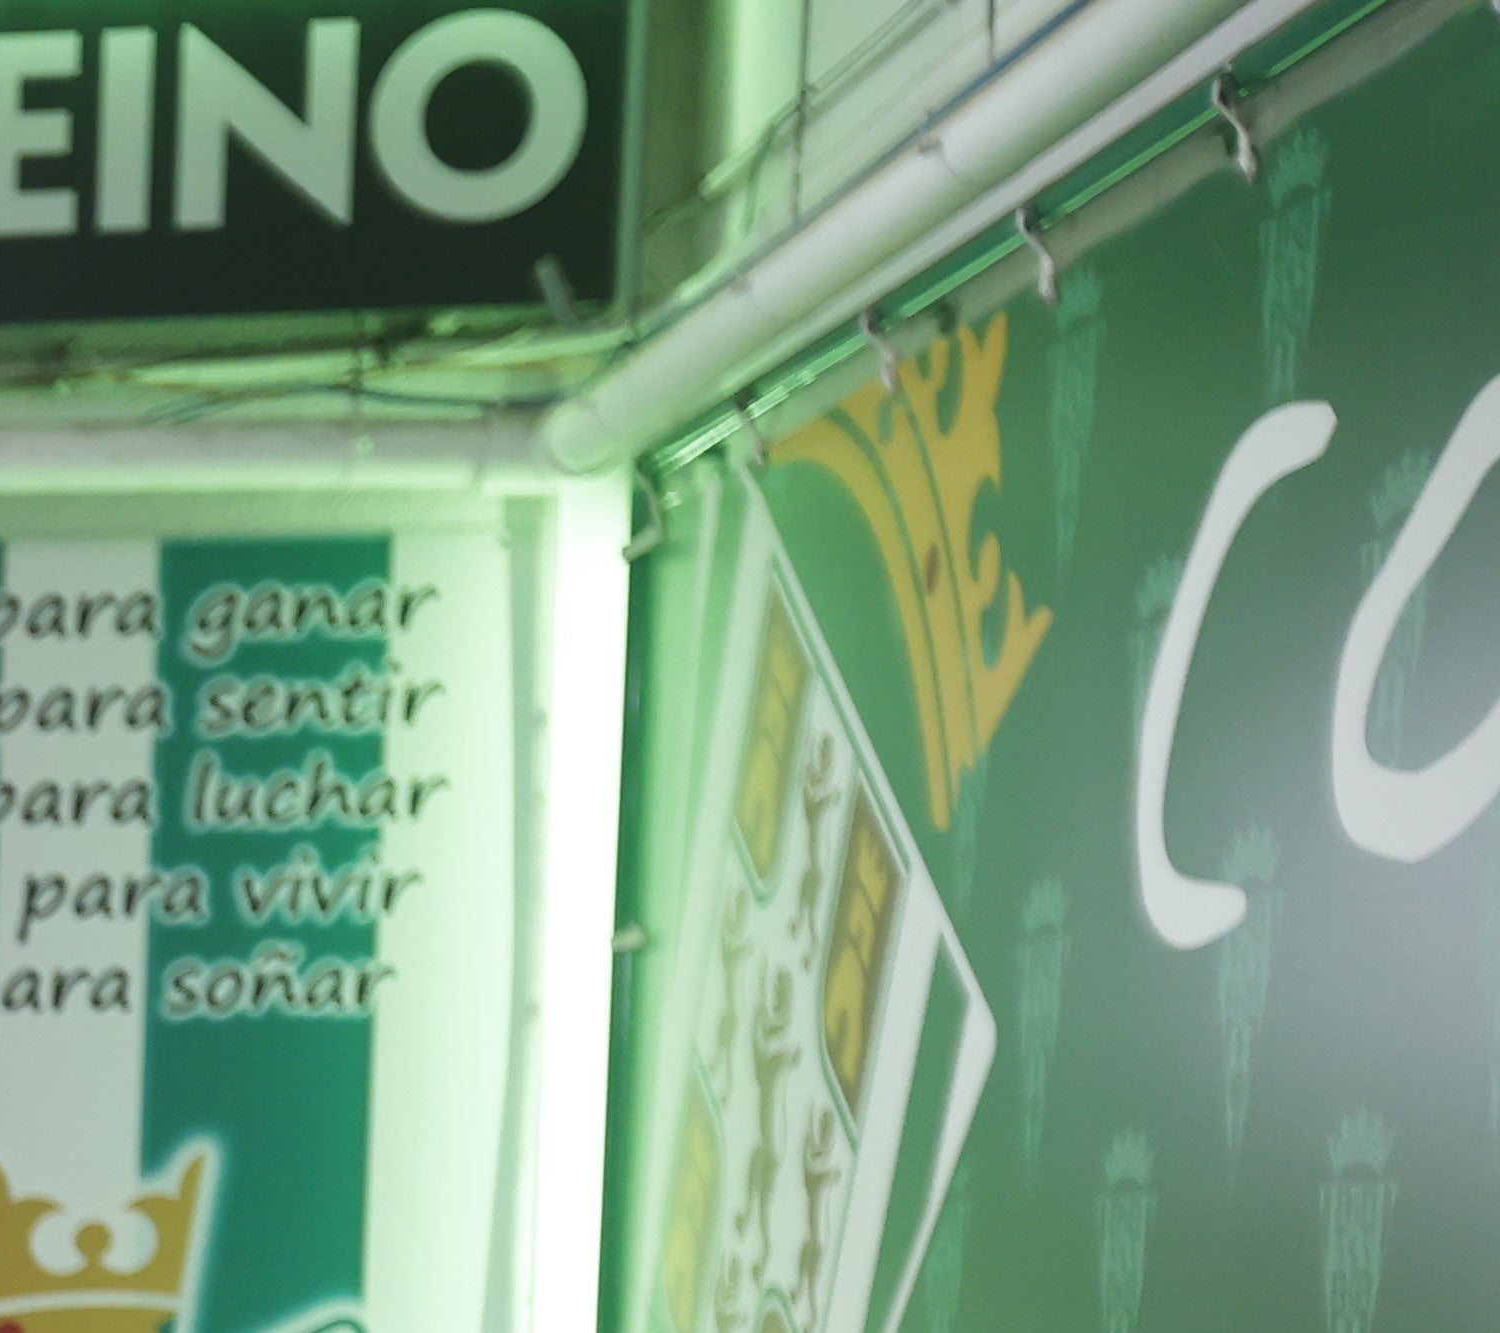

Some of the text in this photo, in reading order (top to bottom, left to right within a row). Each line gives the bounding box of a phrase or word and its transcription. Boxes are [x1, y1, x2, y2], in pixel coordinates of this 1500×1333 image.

[187, 580, 440, 660] ganar
[202, 658, 443, 730] sentir
[191, 749, 447, 828] luchar
[17, 870, 206, 943] para
[241, 847, 425, 923] vivir
[165, 944, 396, 1016] soñar
